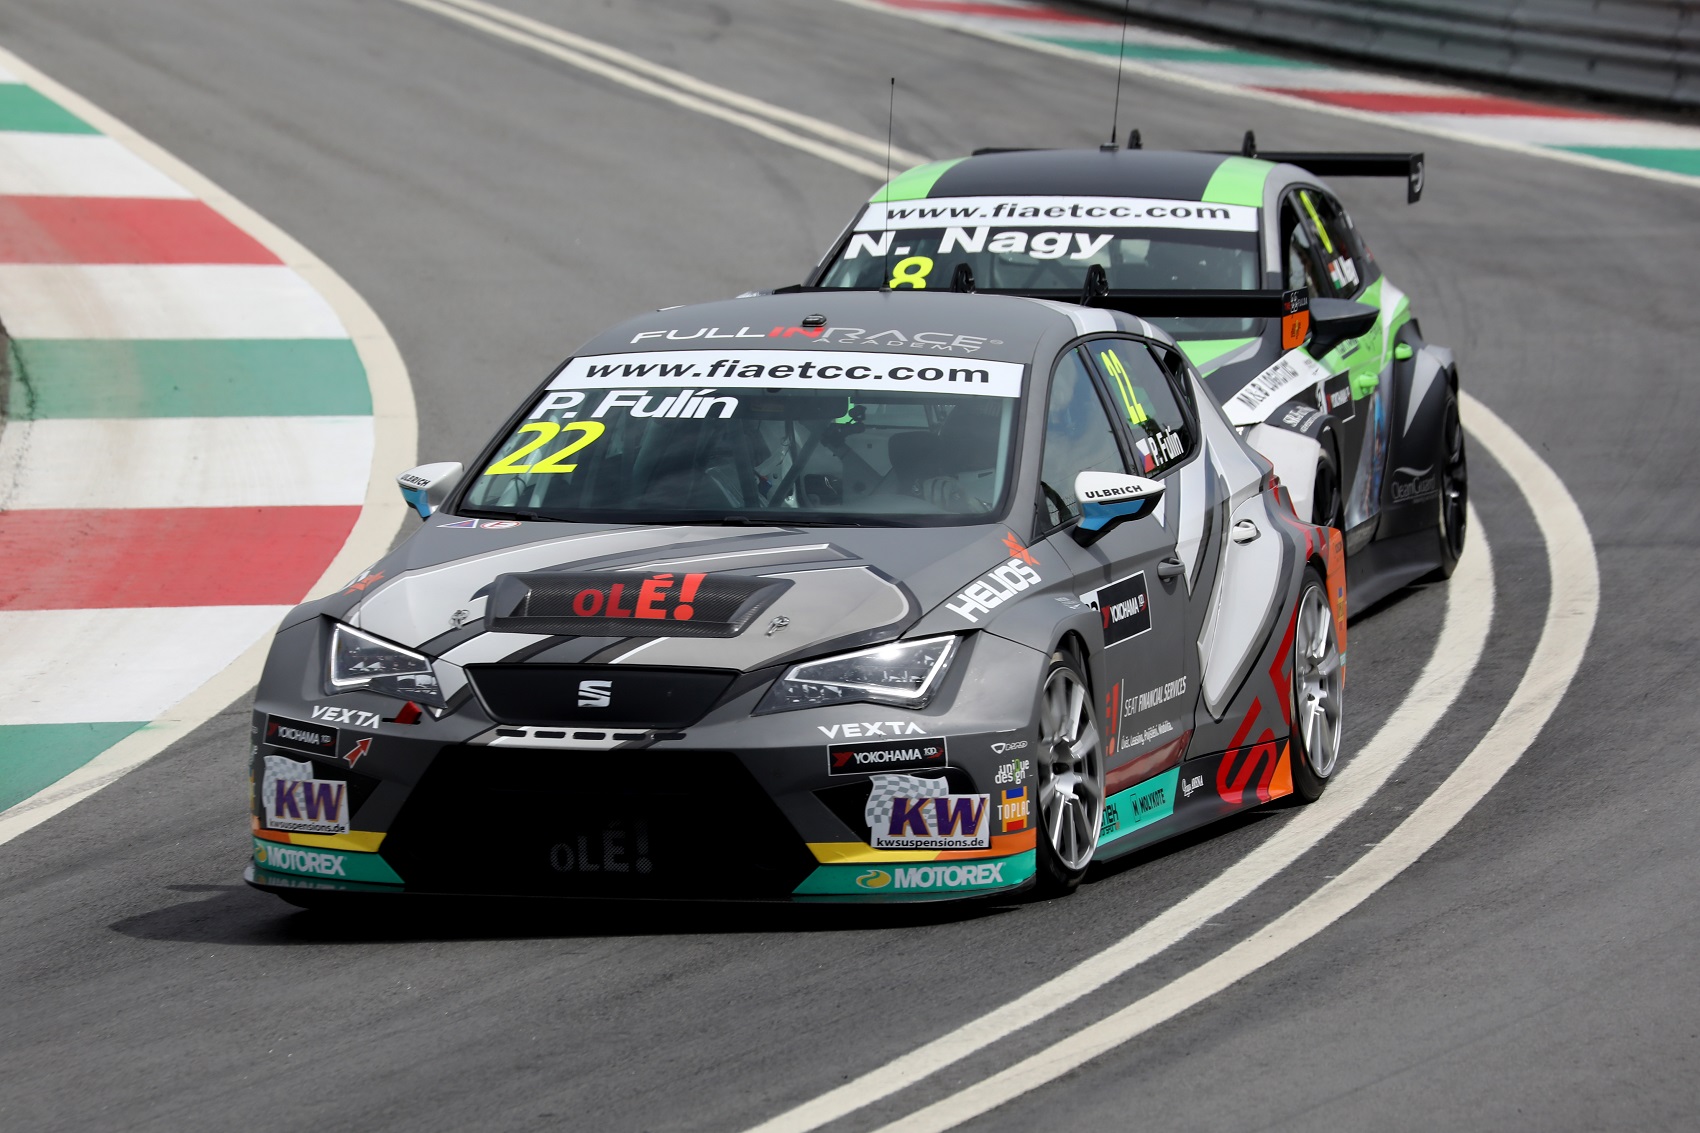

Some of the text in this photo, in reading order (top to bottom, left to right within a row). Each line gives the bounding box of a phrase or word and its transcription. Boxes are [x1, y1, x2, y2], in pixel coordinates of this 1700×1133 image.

[886, 202, 1232, 220] www.fiaetcc.com
[843, 226, 1115, 260] N. Nagy
[888, 256, 934, 288] 8
[812, 335, 981, 354] ACADEMY
[584, 358, 991, 385] www.fiaetcc.com
[1100, 349, 1148, 425] 22
[527, 388, 739, 420] P. Fulín
[483, 420, 606, 476] 22
[400, 473, 431, 487] ULBRICH
[1084, 484, 1144, 500] ULBRICH
[944, 557, 1043, 624] HELIOS
[1110, 596, 1140, 624] YOKOHAMA
[1123, 695, 1139, 717] SEAT
[1163, 675, 1187, 702] SERVICES
[311, 705, 380, 729] VEXTA
[817, 721, 926, 739] VEXTA
[277, 725, 320, 745] YOKOHAMA
[853, 748, 923, 764] YOKOHAMA
[1000, 758, 1030, 775] unique
[994, 769, 1026, 785] design
[274, 779, 345, 823] KW
[996, 799, 1031, 821] TOPLAC
[1138, 787, 1167, 815] MOLYKOTE
[269, 820, 347, 834] kwsuspensions.de
[887, 796, 989, 838] KW
[876, 837, 985, 849] kwsuspensions.de
[266, 845, 347, 877] MOTOREX
[893, 862, 1004, 889] MOTOREX
